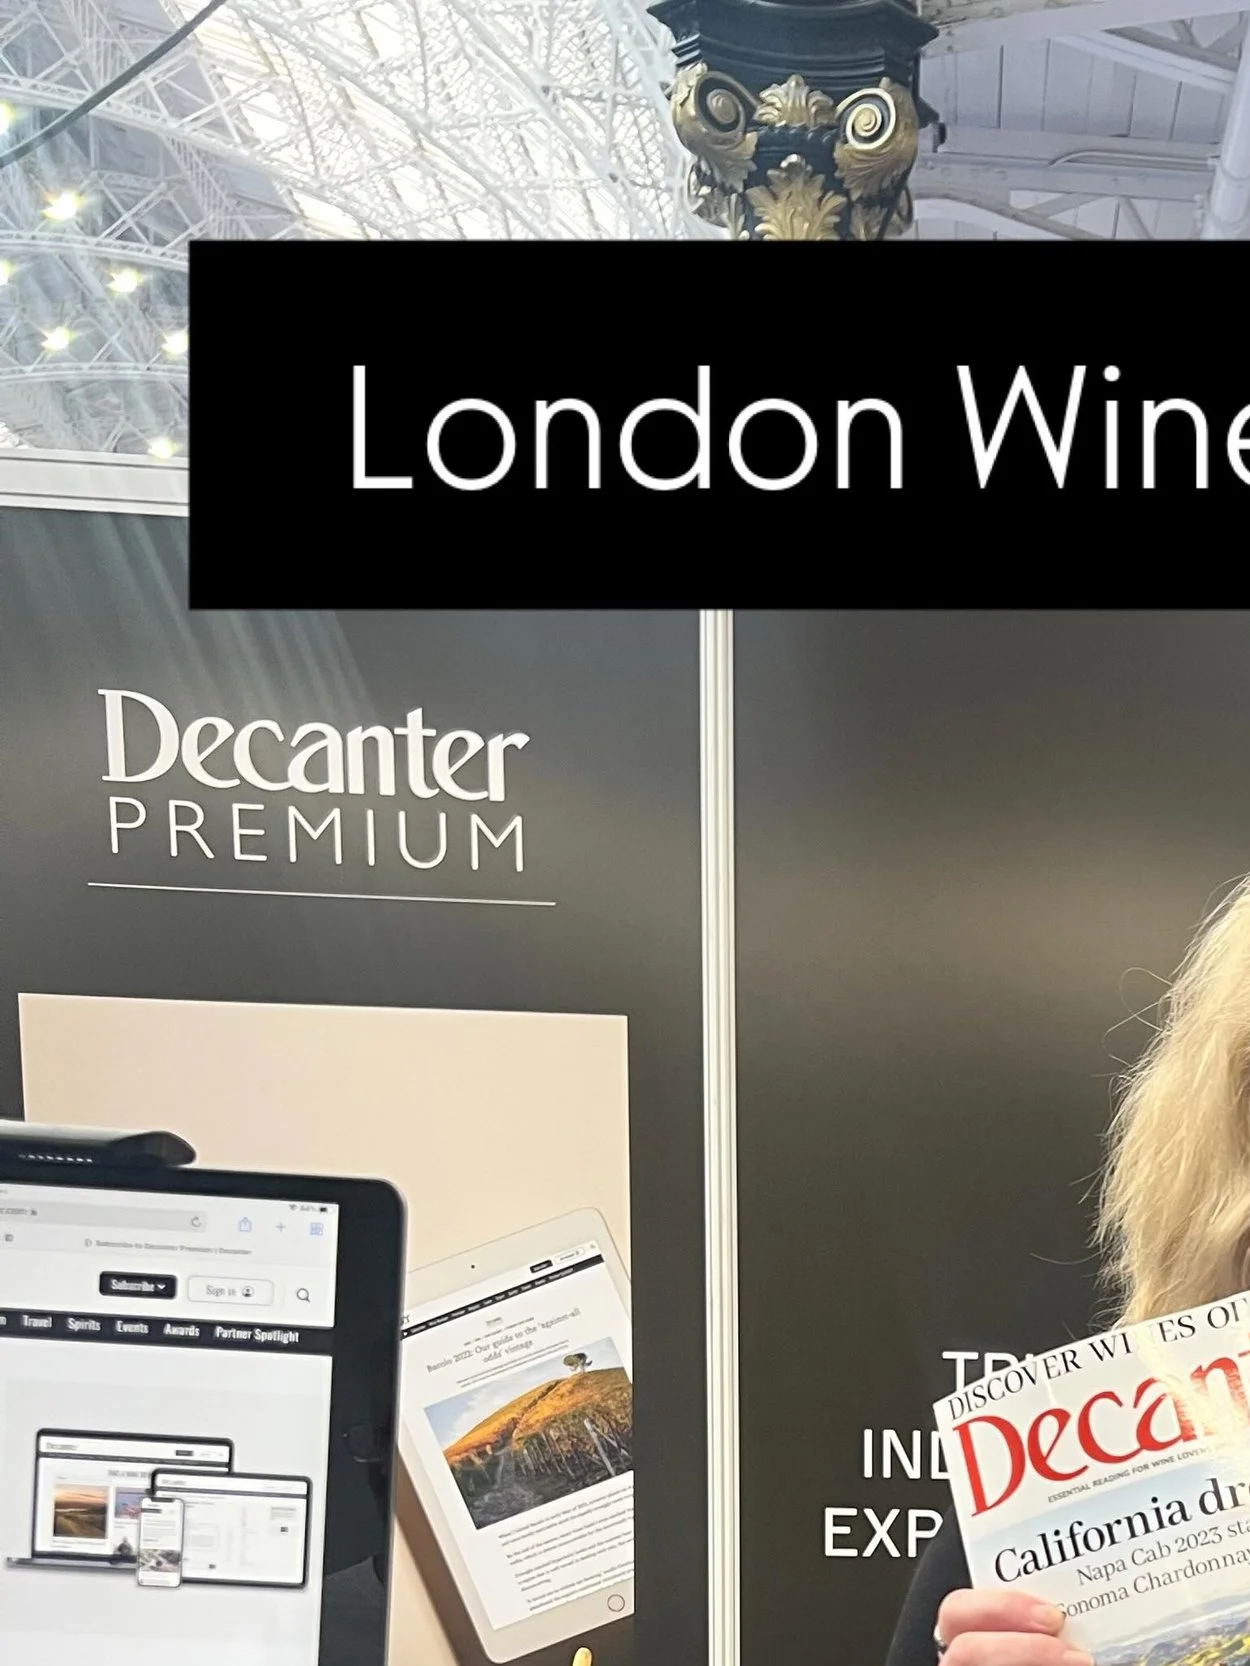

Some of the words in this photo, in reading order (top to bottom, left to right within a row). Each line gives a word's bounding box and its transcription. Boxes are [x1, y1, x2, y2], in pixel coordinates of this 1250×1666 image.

[98, 689, 530, 801] Decanter
[108, 796, 523, 871] PREMIUM
[110, 1278, 155, 1292] Subscribe
[206, 1284, 226, 1297] Sign
[228, 1286, 237, 1296] in
[23, 1314, 52, 1329] Travel
[68, 1317, 101, 1333] Spirits
[116, 1320, 149, 1334] Events
[164, 1323, 200, 1337] Awards
[215, 1326, 252, 1341] Partner
[254, 1328, 300, 1344] Spotlight
[948, 1349, 1083, 1420] DISCOVER
[1088, 1315, 1196, 1362] WIES
[1048, 1484, 1091, 1503] ESSENTIAL
[1093, 1469, 1131, 1487] READING
[1132, 1462, 1151, 1476] FOR
[1152, 1455, 1175, 1470] WINE
[994, 1495, 1192, 1584] California
[1077, 1557, 1128, 1587] Napa
[1131, 1543, 1172, 1567] Cab
[1175, 1525, 1223, 1554] 2023
[1057, 1586, 1130, 1619] Sonoma
